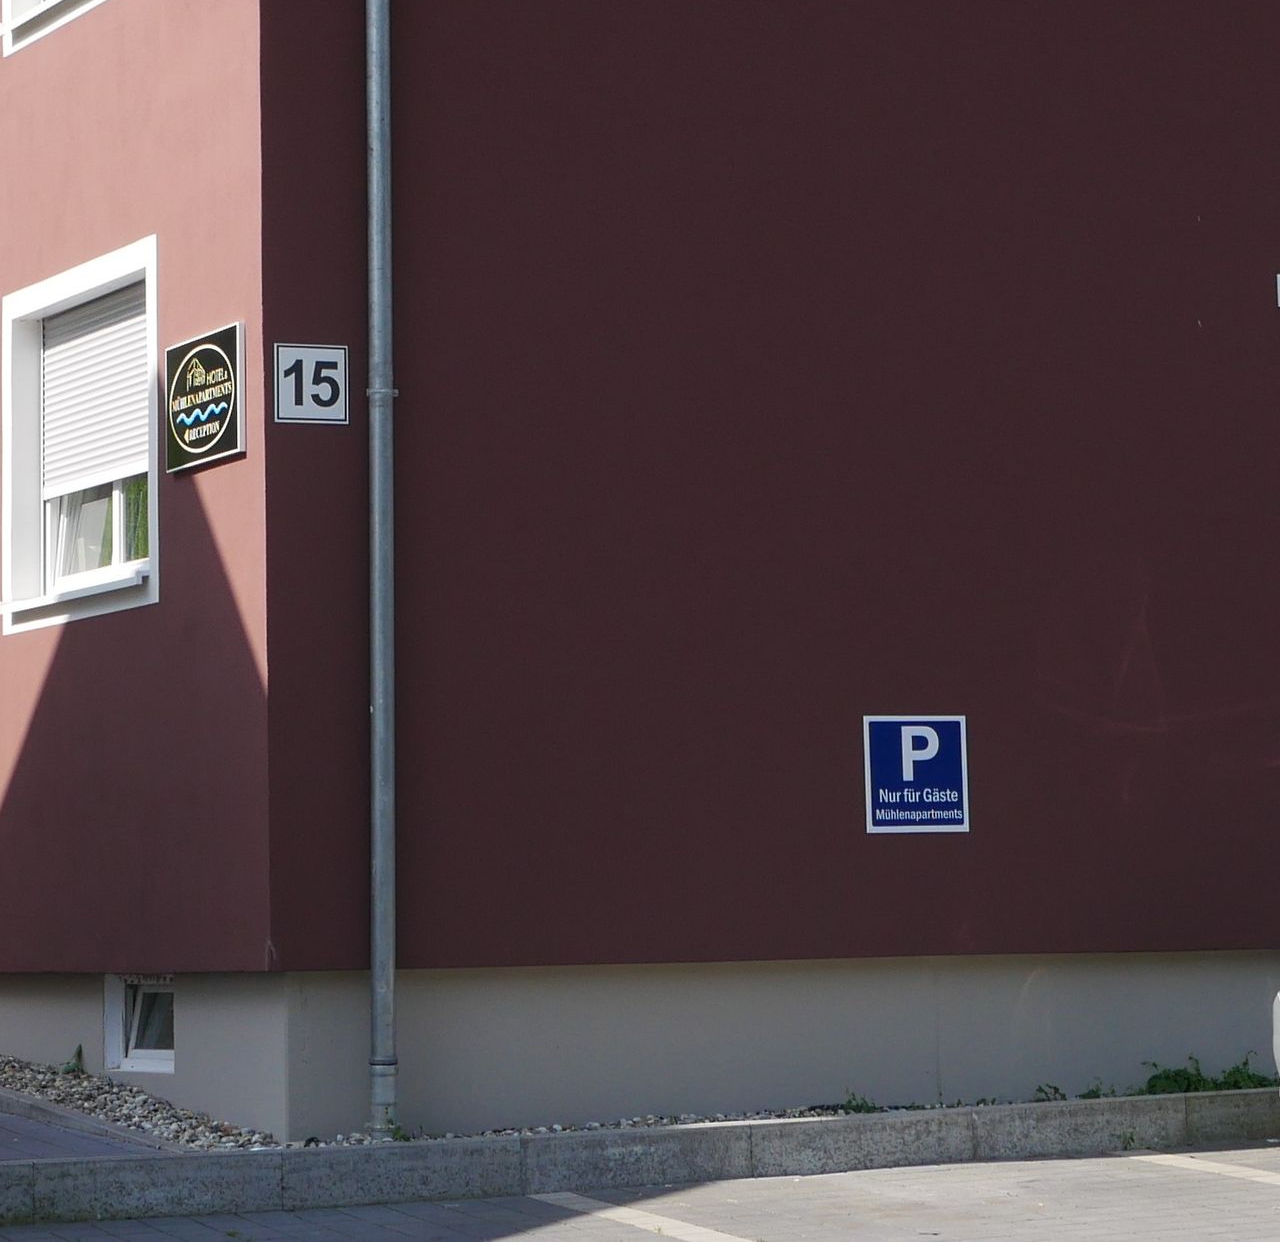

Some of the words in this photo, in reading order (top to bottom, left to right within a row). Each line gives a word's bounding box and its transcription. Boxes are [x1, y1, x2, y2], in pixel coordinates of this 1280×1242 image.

[206, 367, 224, 385] HOTEL
[283, 359, 340, 408] 15
[172, 381, 232, 412] MÜHLENAPARTMENTS
[901, 726, 939, 781] P
[879, 788, 901, 803] Nur
[903, 788, 921, 802] für
[923, 788, 959, 802] Gäste
[876, 809, 963, 822] Mühlenapartments
